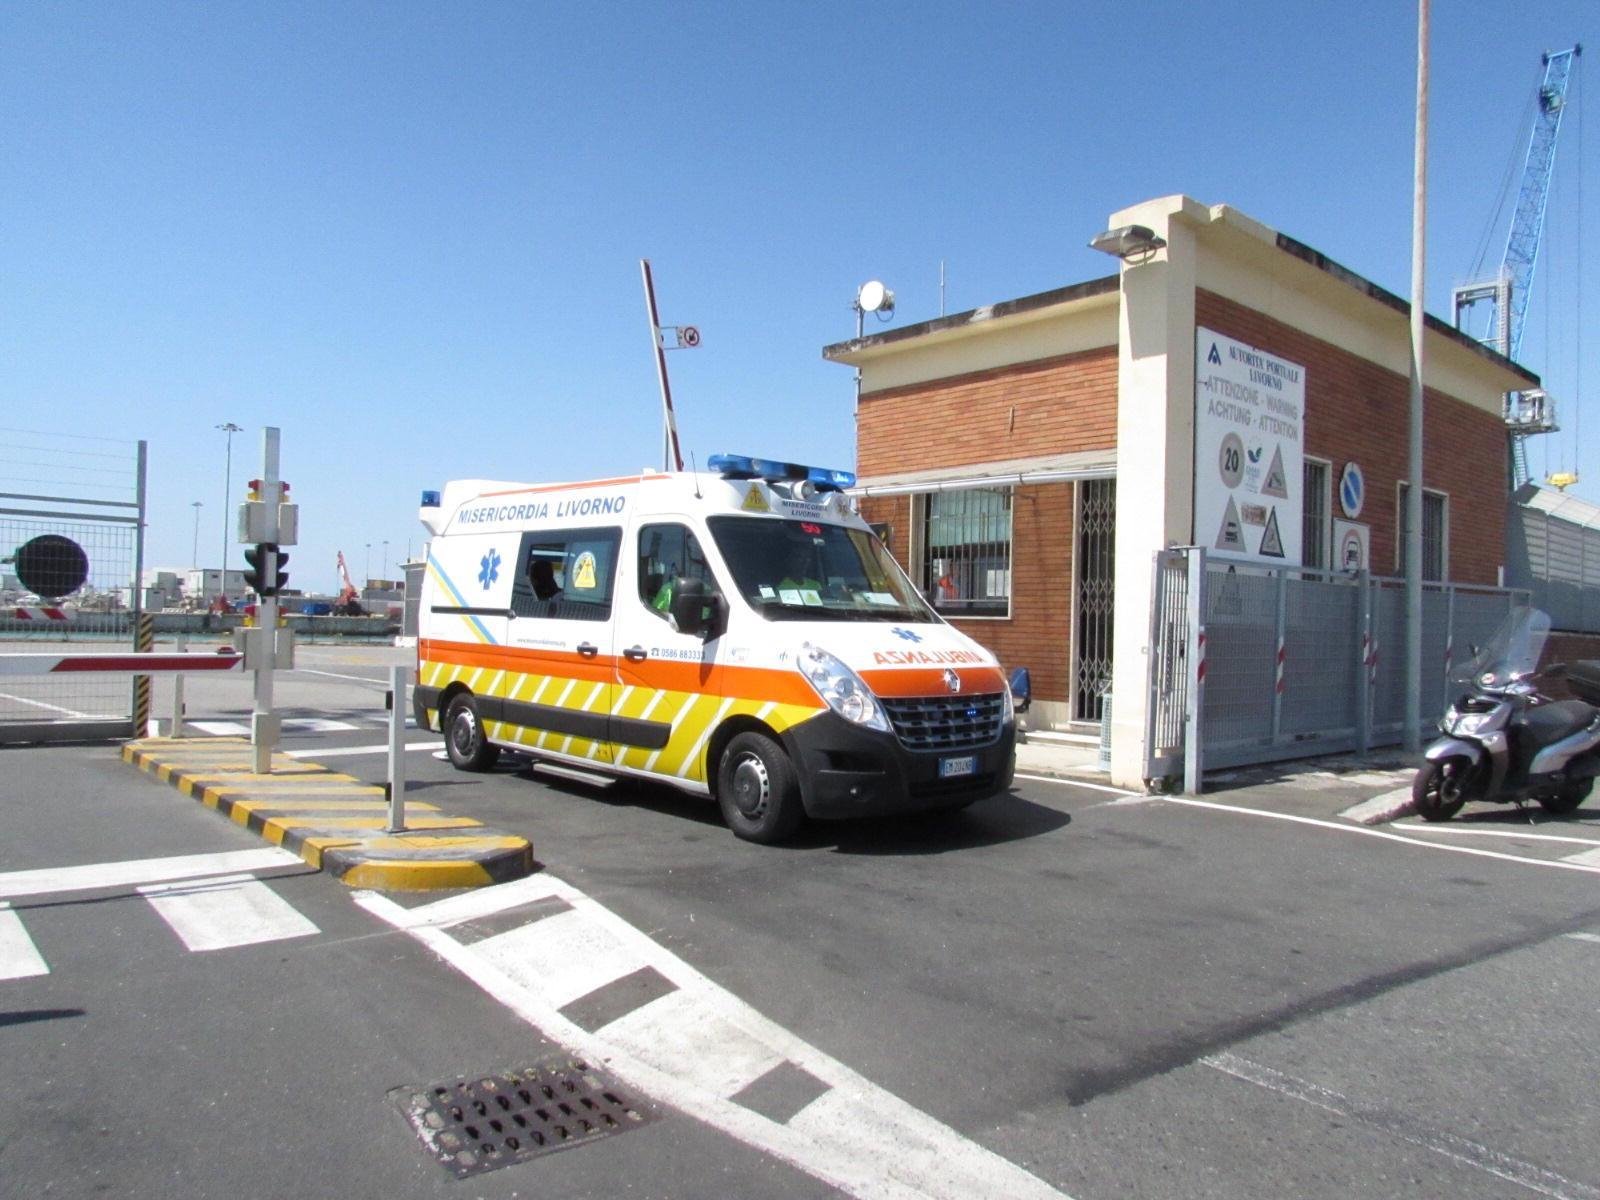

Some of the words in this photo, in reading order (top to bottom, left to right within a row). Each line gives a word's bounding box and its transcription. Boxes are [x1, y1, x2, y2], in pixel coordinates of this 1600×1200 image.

[1249, 368, 1282, 391] LIVORNO
[1266, 359, 1299, 383] PORTUALE
[1206, 374, 1259, 406] ATTENZIONE
[1265, 393, 1298, 420] WARNING
[1207, 399, 1251, 426] ACHTUNG
[1258, 414, 1298, 441] ATTENTION
[1225, 447, 1239, 472] 20
[457, 502, 548, 524] MISERICORDIA
[556, 495, 626, 518] LIVORNO
[791, 509, 821, 518] LIVORNO
[661, 648, 678, 658] 0586
